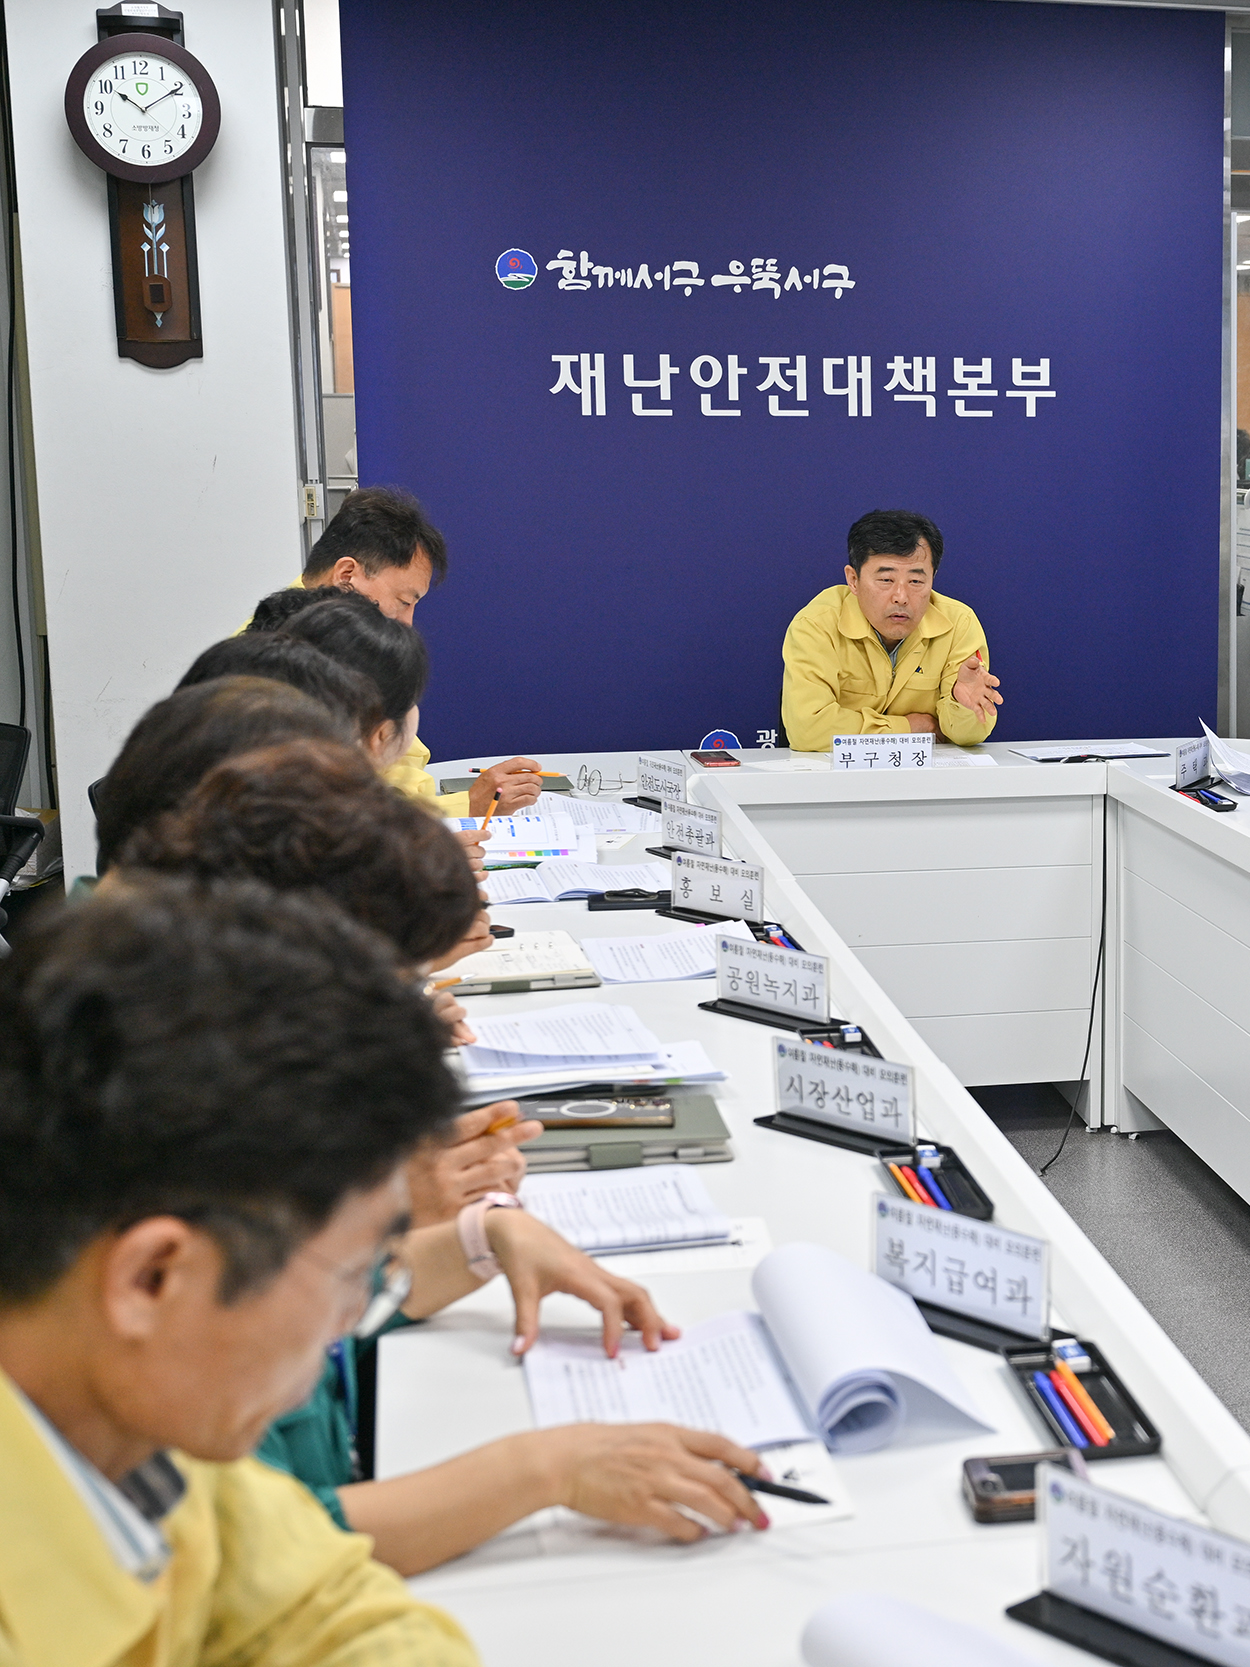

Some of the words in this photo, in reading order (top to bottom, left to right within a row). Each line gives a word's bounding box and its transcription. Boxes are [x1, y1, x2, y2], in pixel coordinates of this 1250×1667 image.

[113, 65, 126, 80] 11
[132, 60, 148, 75] 12
[159, 66, 165, 80] 1
[98, 79, 113, 94] 10
[173, 81, 183, 96] 2
[94, 100, 104, 116] 9
[182, 103, 192, 119] 3
[102, 122, 113, 138] 8
[177, 124, 186, 139] 4
[119, 139, 128, 153] 7
[141, 144, 151, 159] 6
[164, 139, 173, 154] 5
[545, 249, 705, 297] 함께서구
[710, 257, 855, 299] 우뚝서구
[549, 352, 1057, 418] 재난안전대책본부
[839, 750, 927, 768] 부구청장
[641, 774, 681, 800] 안전도시국장
[667, 820, 715, 850] 안전총괄과
[727, 965, 819, 1010] 공원녹지과
[786, 1073, 902, 1128] 시장산업과
[883, 1236, 1033, 1315] 복지급여과
